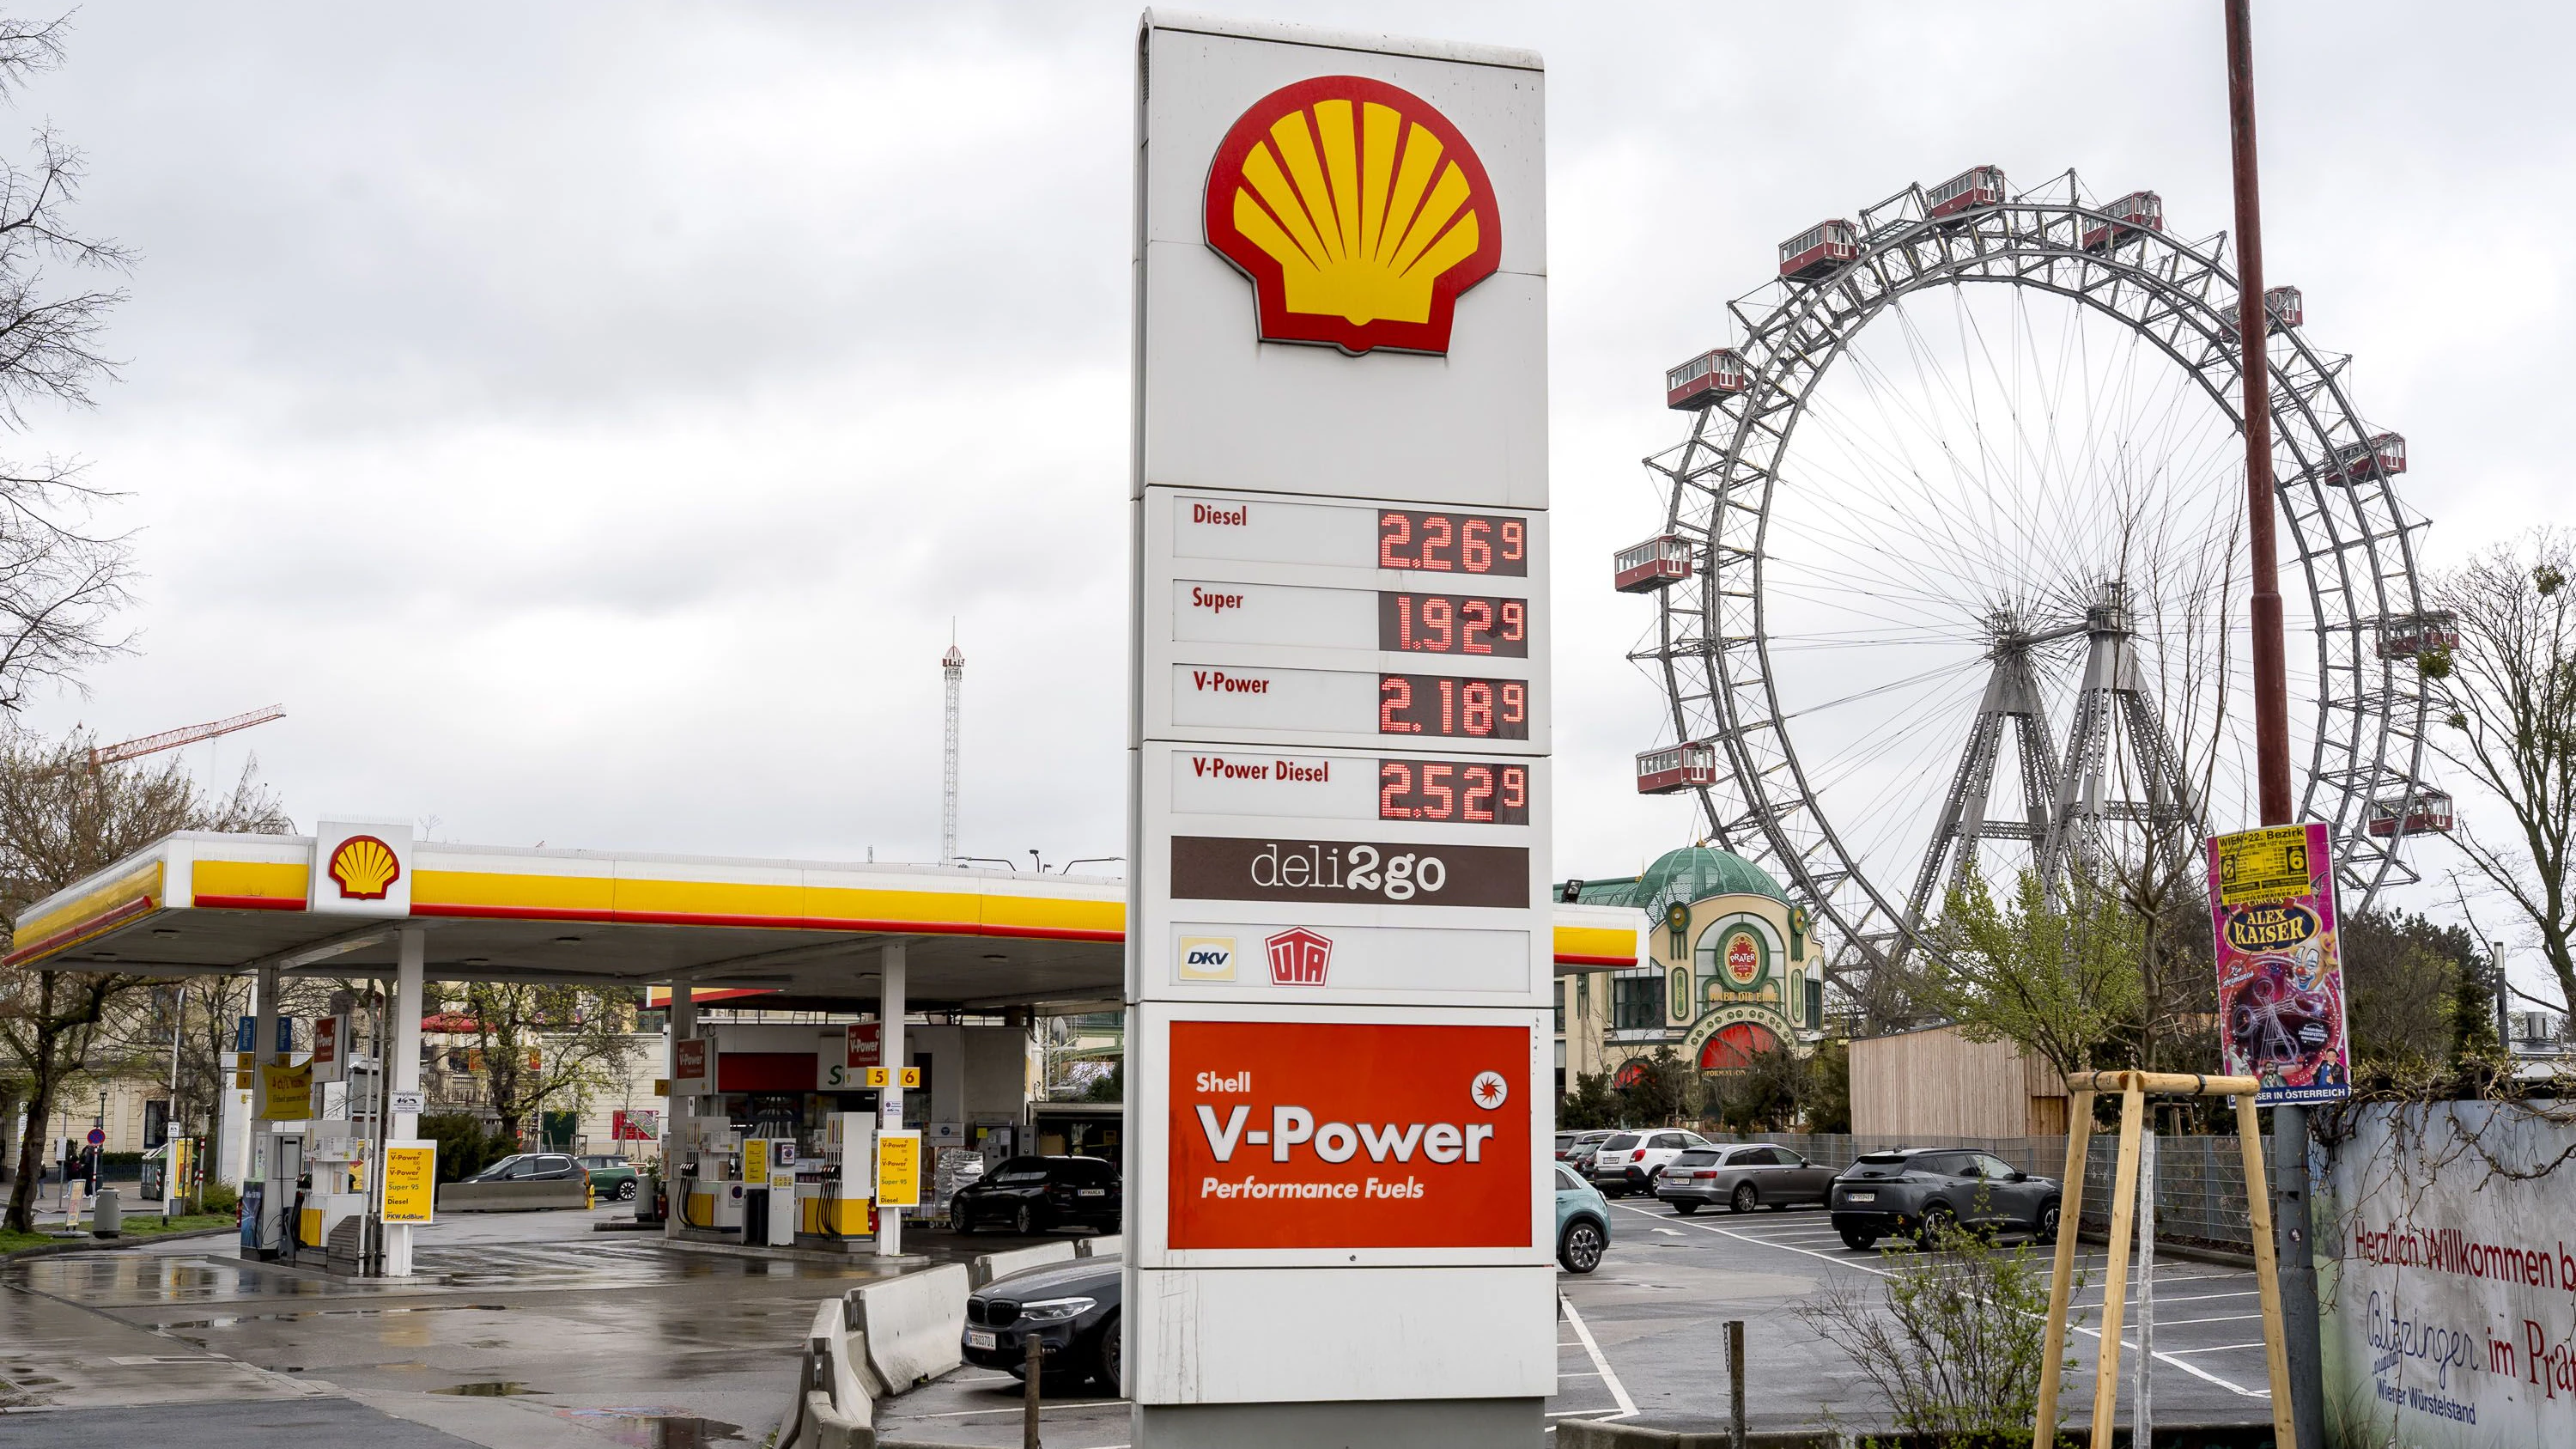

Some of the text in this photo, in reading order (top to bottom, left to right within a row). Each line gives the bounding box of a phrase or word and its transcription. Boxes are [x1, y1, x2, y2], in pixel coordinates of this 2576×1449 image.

[1194, 503, 1247, 527] Diesel
[1193, 587, 1244, 613] Super
[1194, 670, 1270, 693] V-Power
[1193, 757, 1329, 782] V-Power Diesel
[2267, 828, 2305, 839] Bezirk
[2289, 850, 2305, 869] 6
[1251, 843, 1446, 901] deli2go
[2246, 908, 2287, 925] ALEX
[2233, 916, 2306, 945] KAISER
[1188, 952, 1230, 965] DKV
[1269, 930, 1330, 984] UTA
[1729, 953, 1755, 963] PRATER
[1738, 993, 1753, 1002] DIE
[242, 1020, 252, 1048] AdBlue
[850, 1039, 879, 1053] V-Power
[828, 1065, 845, 1086] S
[874, 1070, 884, 1084] 5
[905, 1070, 915, 1084] 6
[1196, 1071, 1250, 1093] Shell
[2255, 1088, 2345, 1101] ISER IN ÖSTERREICH
[1194, 1105, 1494, 1164] V-Power
[1201, 1176, 1425, 1200] Performance Fuels
[2354, 1220, 2420, 1268] Herzlich
[2421, 1227, 2555, 1288] Willkommen
[2366, 1290, 2479, 1391] Bitzinger
[2488, 1326, 2516, 1378] im
[2377, 1378, 2476, 1426] Wiener Würstelstand
